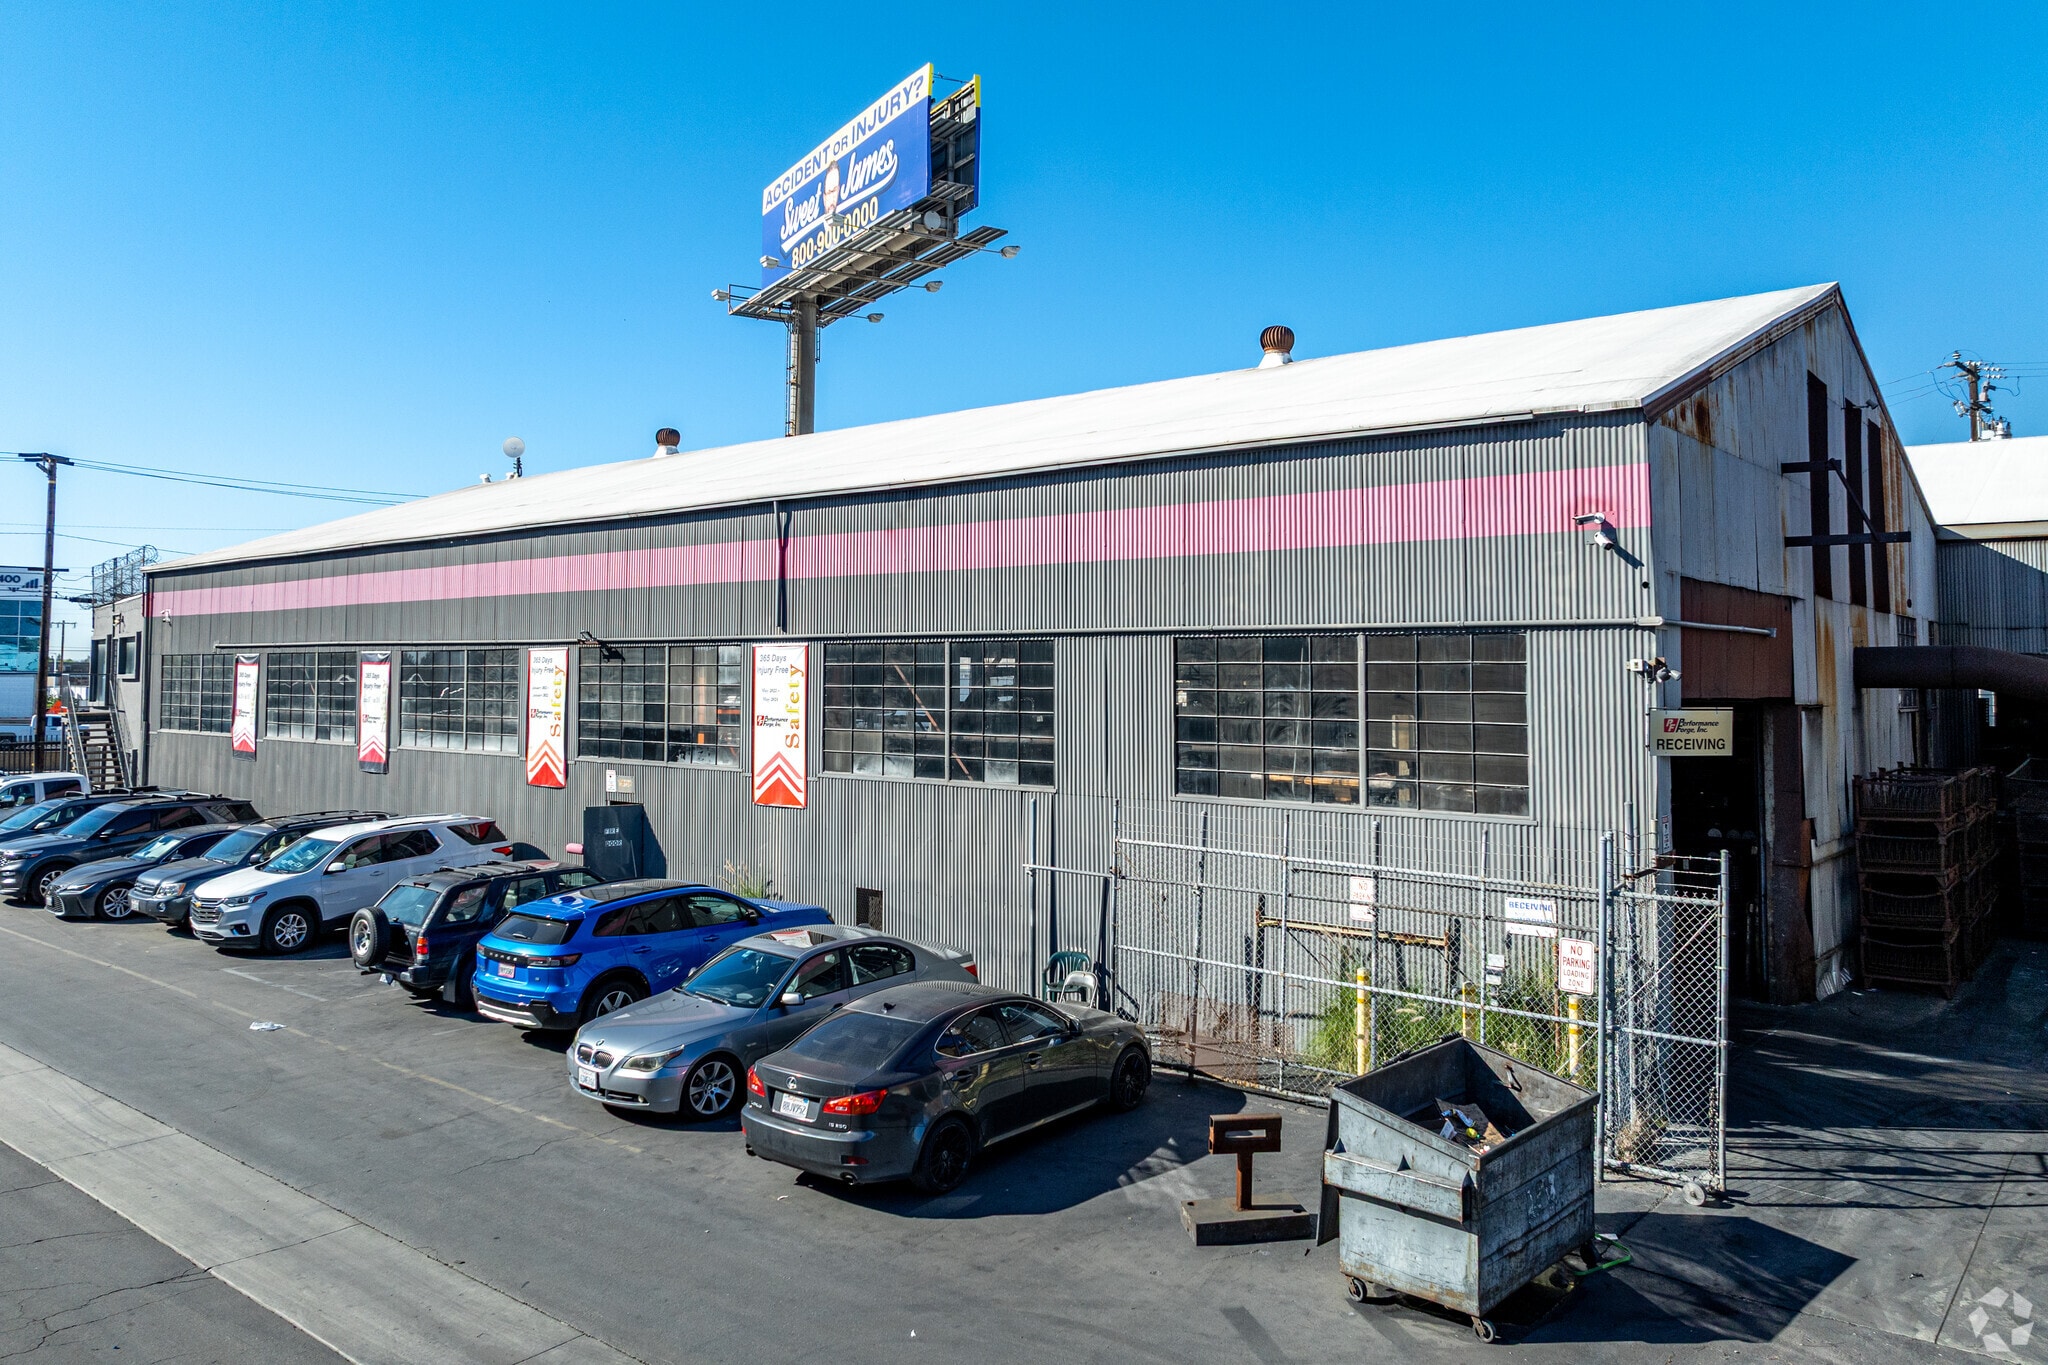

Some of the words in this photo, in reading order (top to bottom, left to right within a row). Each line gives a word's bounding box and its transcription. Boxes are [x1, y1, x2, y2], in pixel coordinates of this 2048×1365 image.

[765, 144, 831, 209] ACCIDENT
[833, 135, 849, 156] OR
[852, 75, 924, 144] INJURY?
[780, 183, 823, 238] Sweet
[840, 140, 895, 199] James
[759, 654, 770, 662] 365
[772, 654, 787, 664] Days
[775, 666, 789, 674] Free
[550, 665, 565, 737] Safety
[785, 664, 804, 748] Safety
[1679, 718, 1719, 727] Performance
[1676, 726, 1695, 734] Forge,
[1656, 738, 1726, 750] RECEIVING
[1508, 901, 1553, 912] RECEIVING
[1570, 945, 1583, 956] NO
[1562, 957, 1591, 970] PARKING
[1563, 968, 1590, 980] LOADING
[1567, 978, 1584, 988] ZONE
